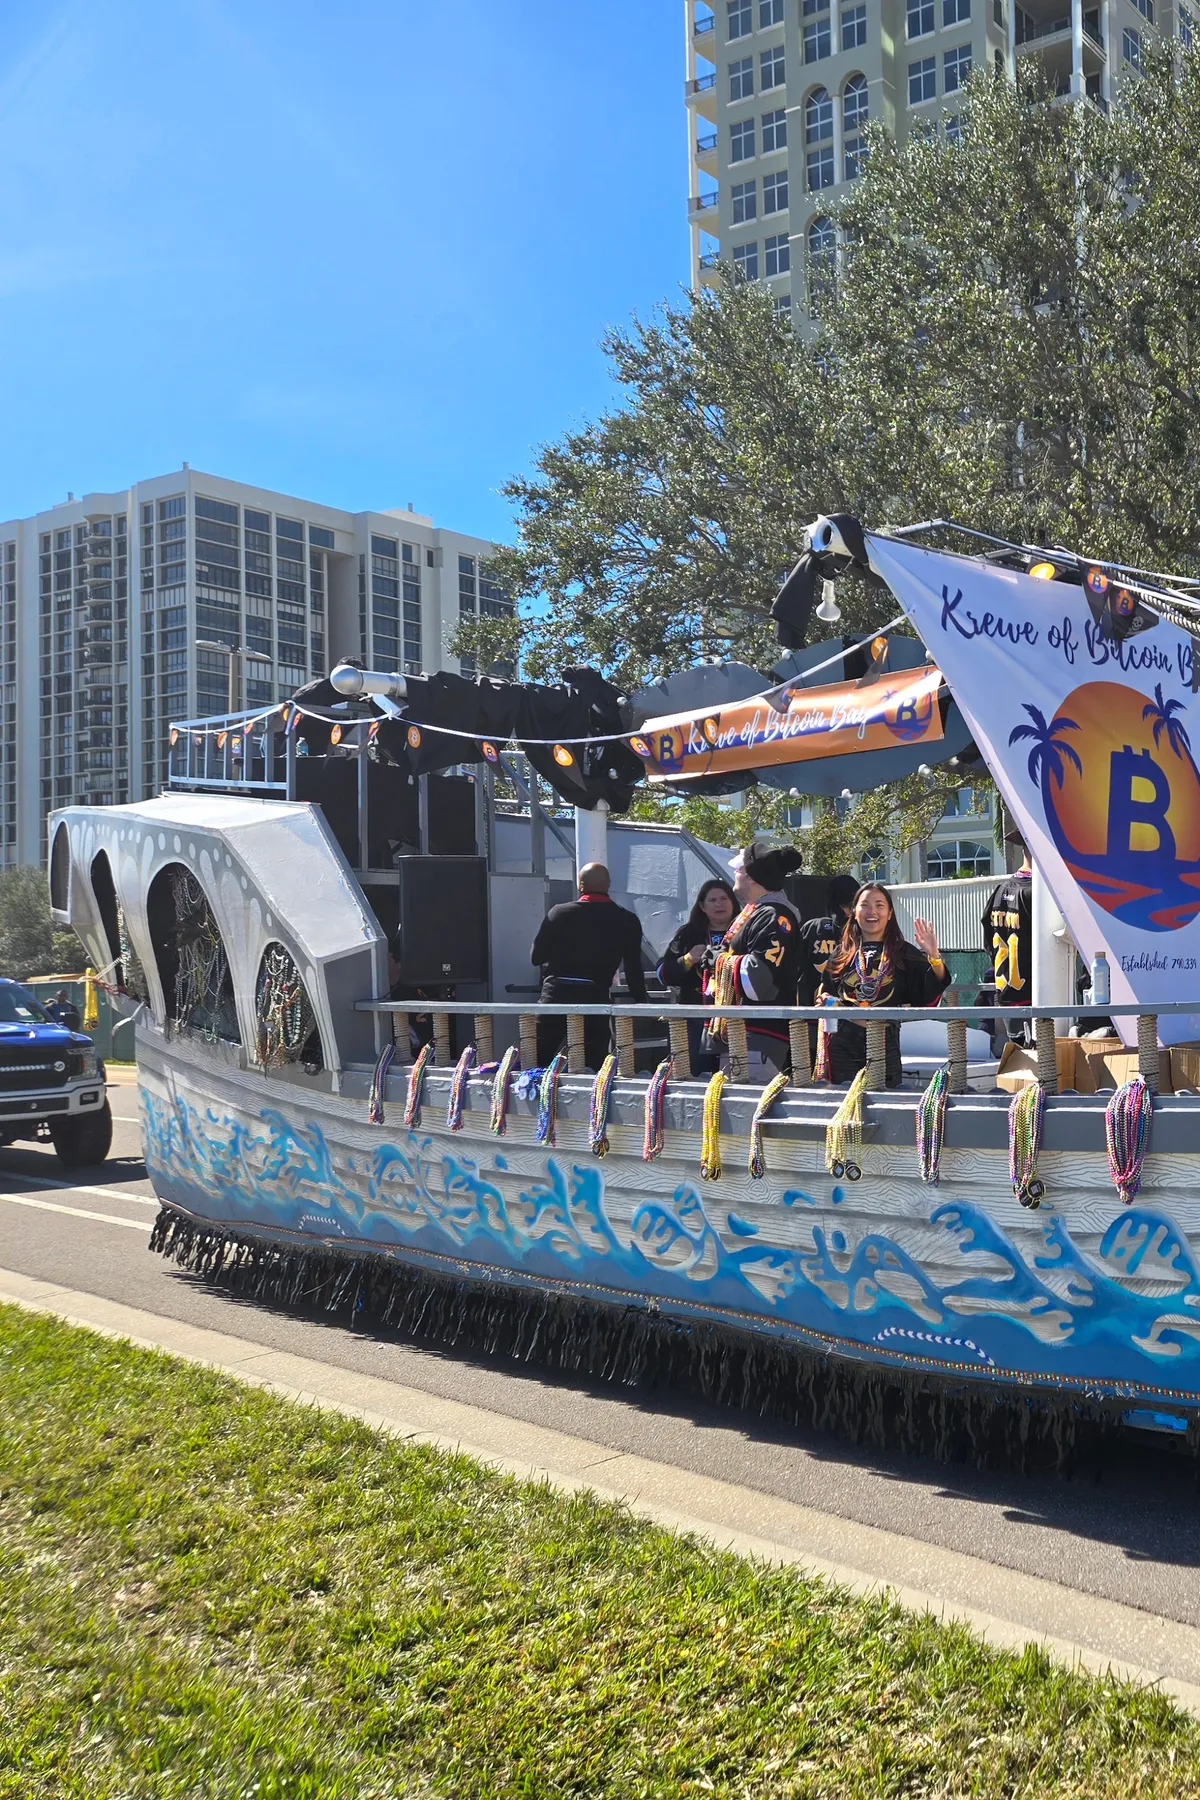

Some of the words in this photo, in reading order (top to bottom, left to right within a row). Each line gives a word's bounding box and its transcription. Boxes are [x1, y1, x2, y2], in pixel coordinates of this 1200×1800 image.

[941, 584, 1039, 645] Krewe
[1047, 616, 1079, 665] of
[740, 709, 762, 750] of
[763, 704, 827, 744] Bitcoin
[829, 697, 868, 740] Bay
[765, 940, 786, 968] 21
[992, 932, 1026, 993] 21
